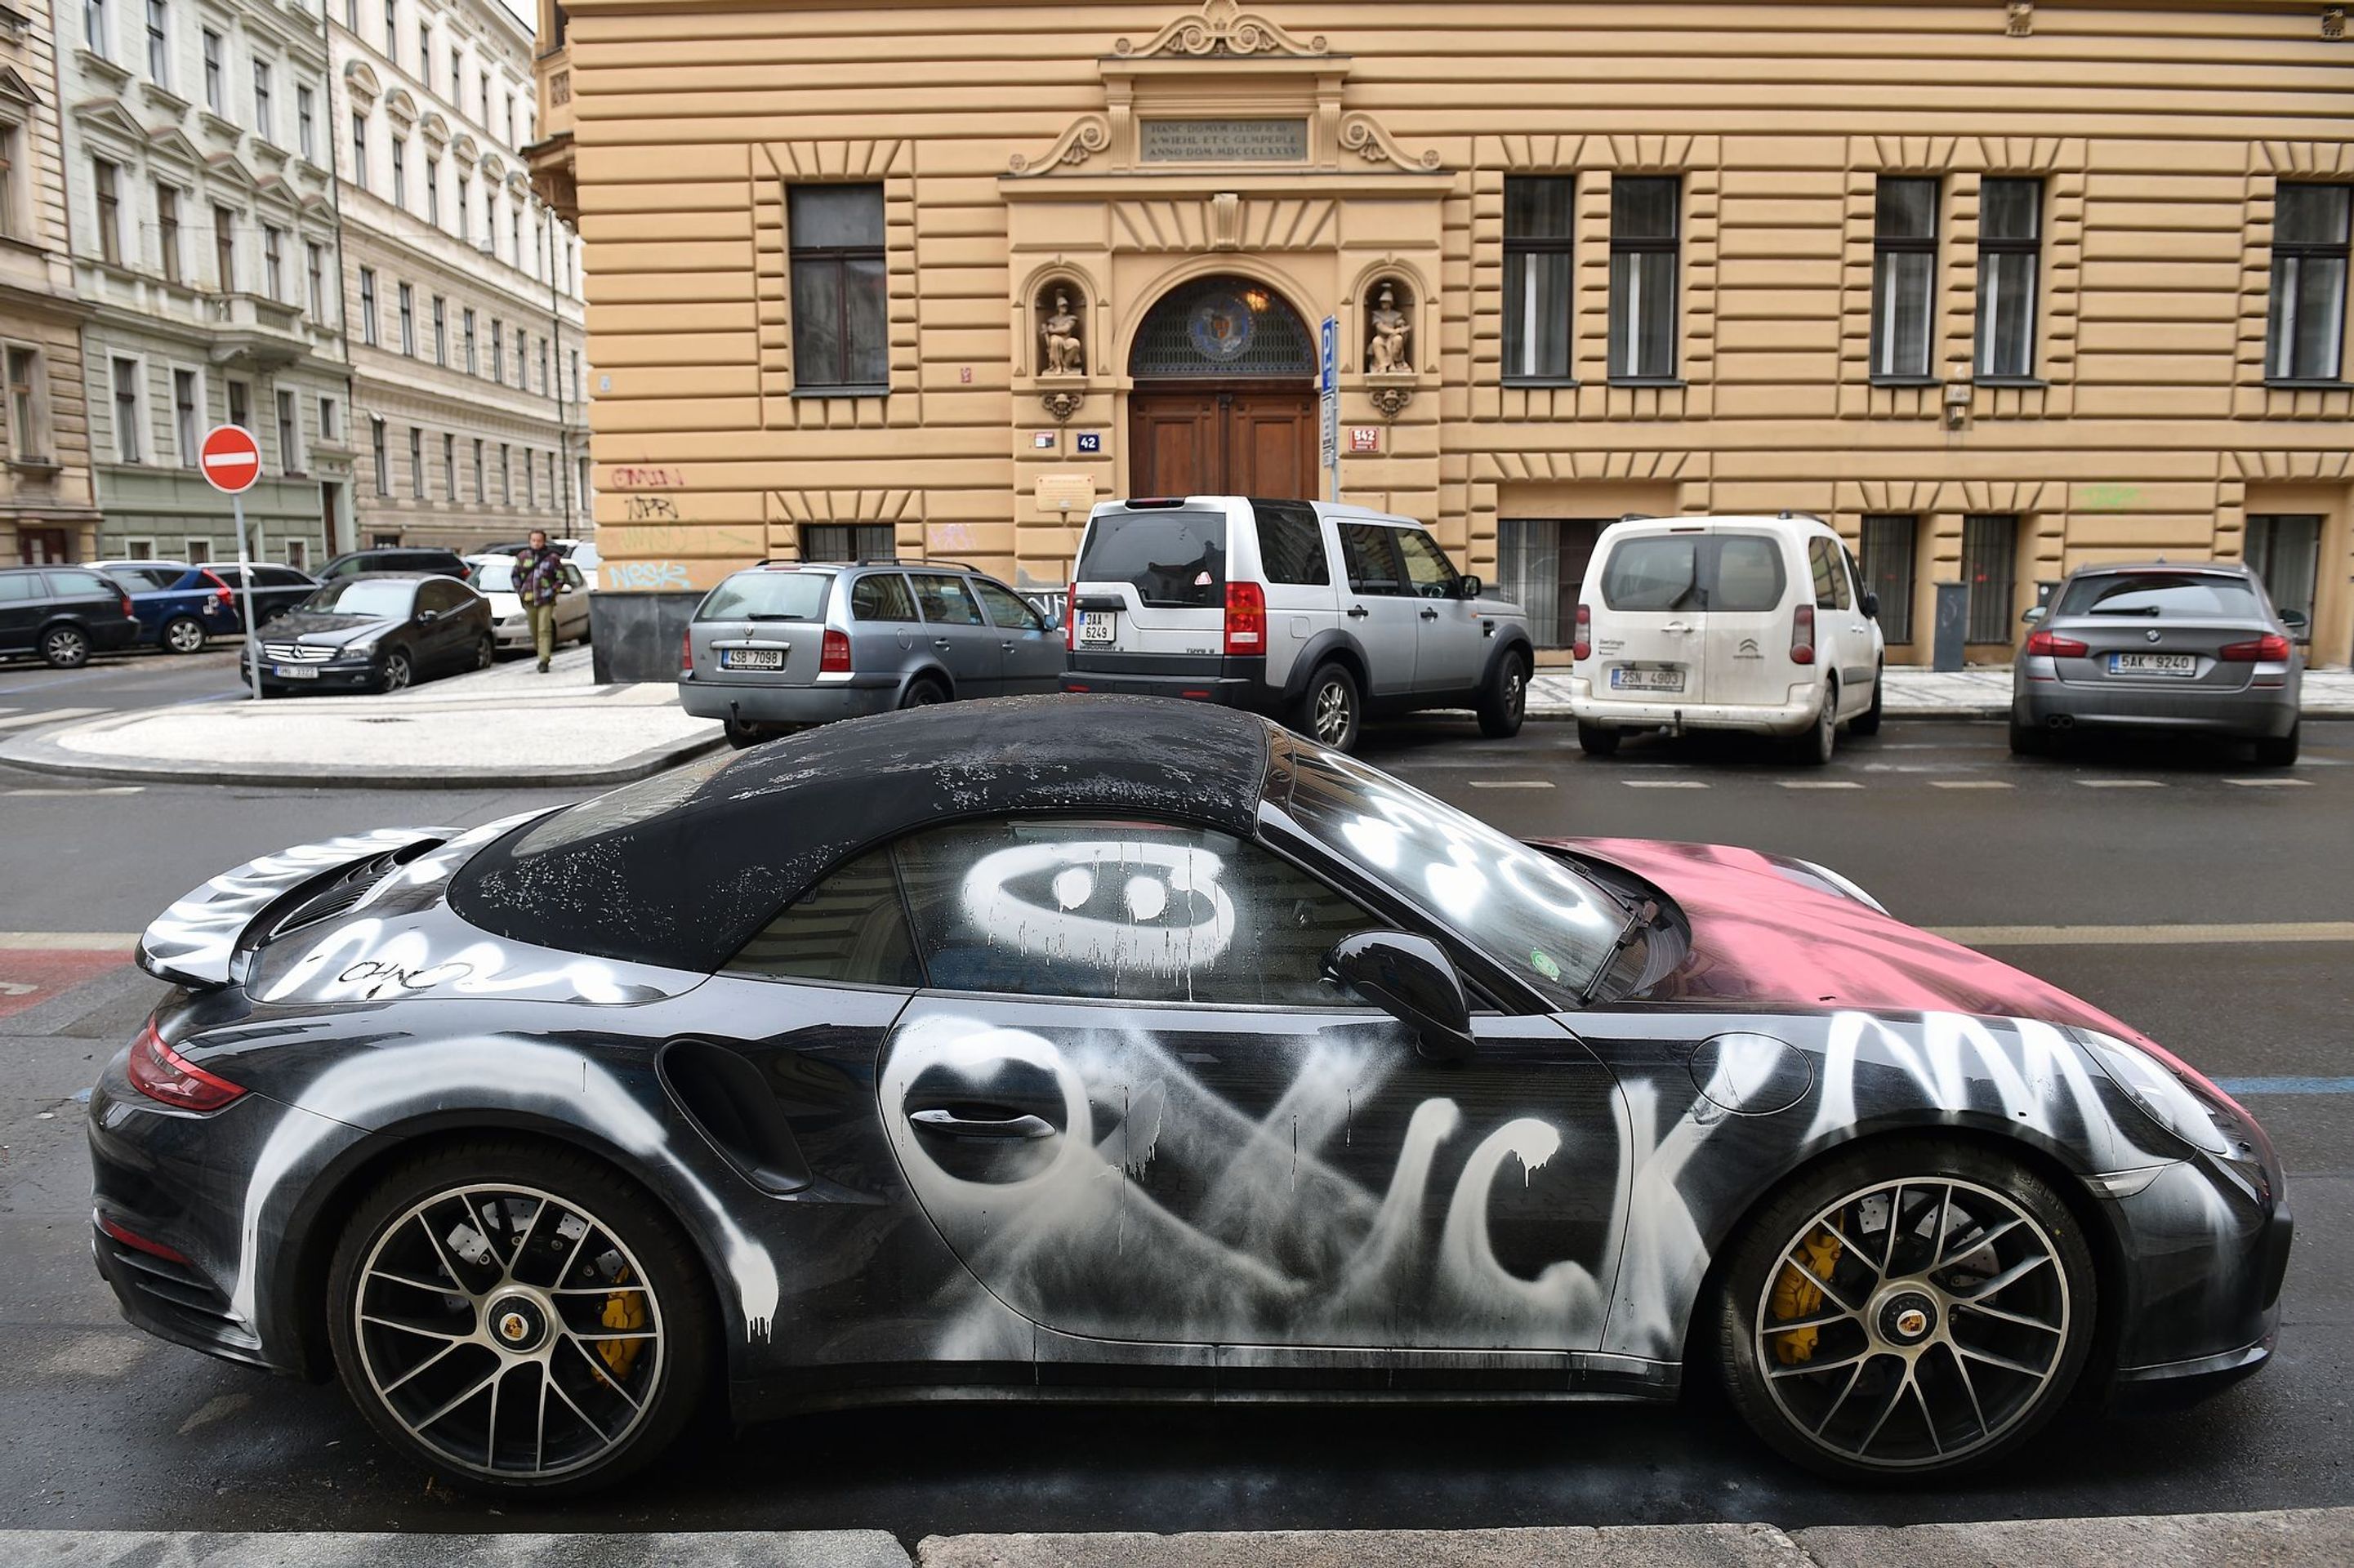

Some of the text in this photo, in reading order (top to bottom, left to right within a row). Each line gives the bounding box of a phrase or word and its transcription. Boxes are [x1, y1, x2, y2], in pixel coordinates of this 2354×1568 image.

[1149, 148, 1183, 156] ANNO
[1354, 430, 1375, 441] 542
[1080, 437, 1096, 448] 42
[1086, 613, 1102, 626] 3AA
[1086, 626, 1108, 639] 6249
[730, 651, 778, 664] 4SB 7098
[2122, 654, 2190, 668] 5AK 9240
[1621, 671, 1679, 684] 2SN 4903
